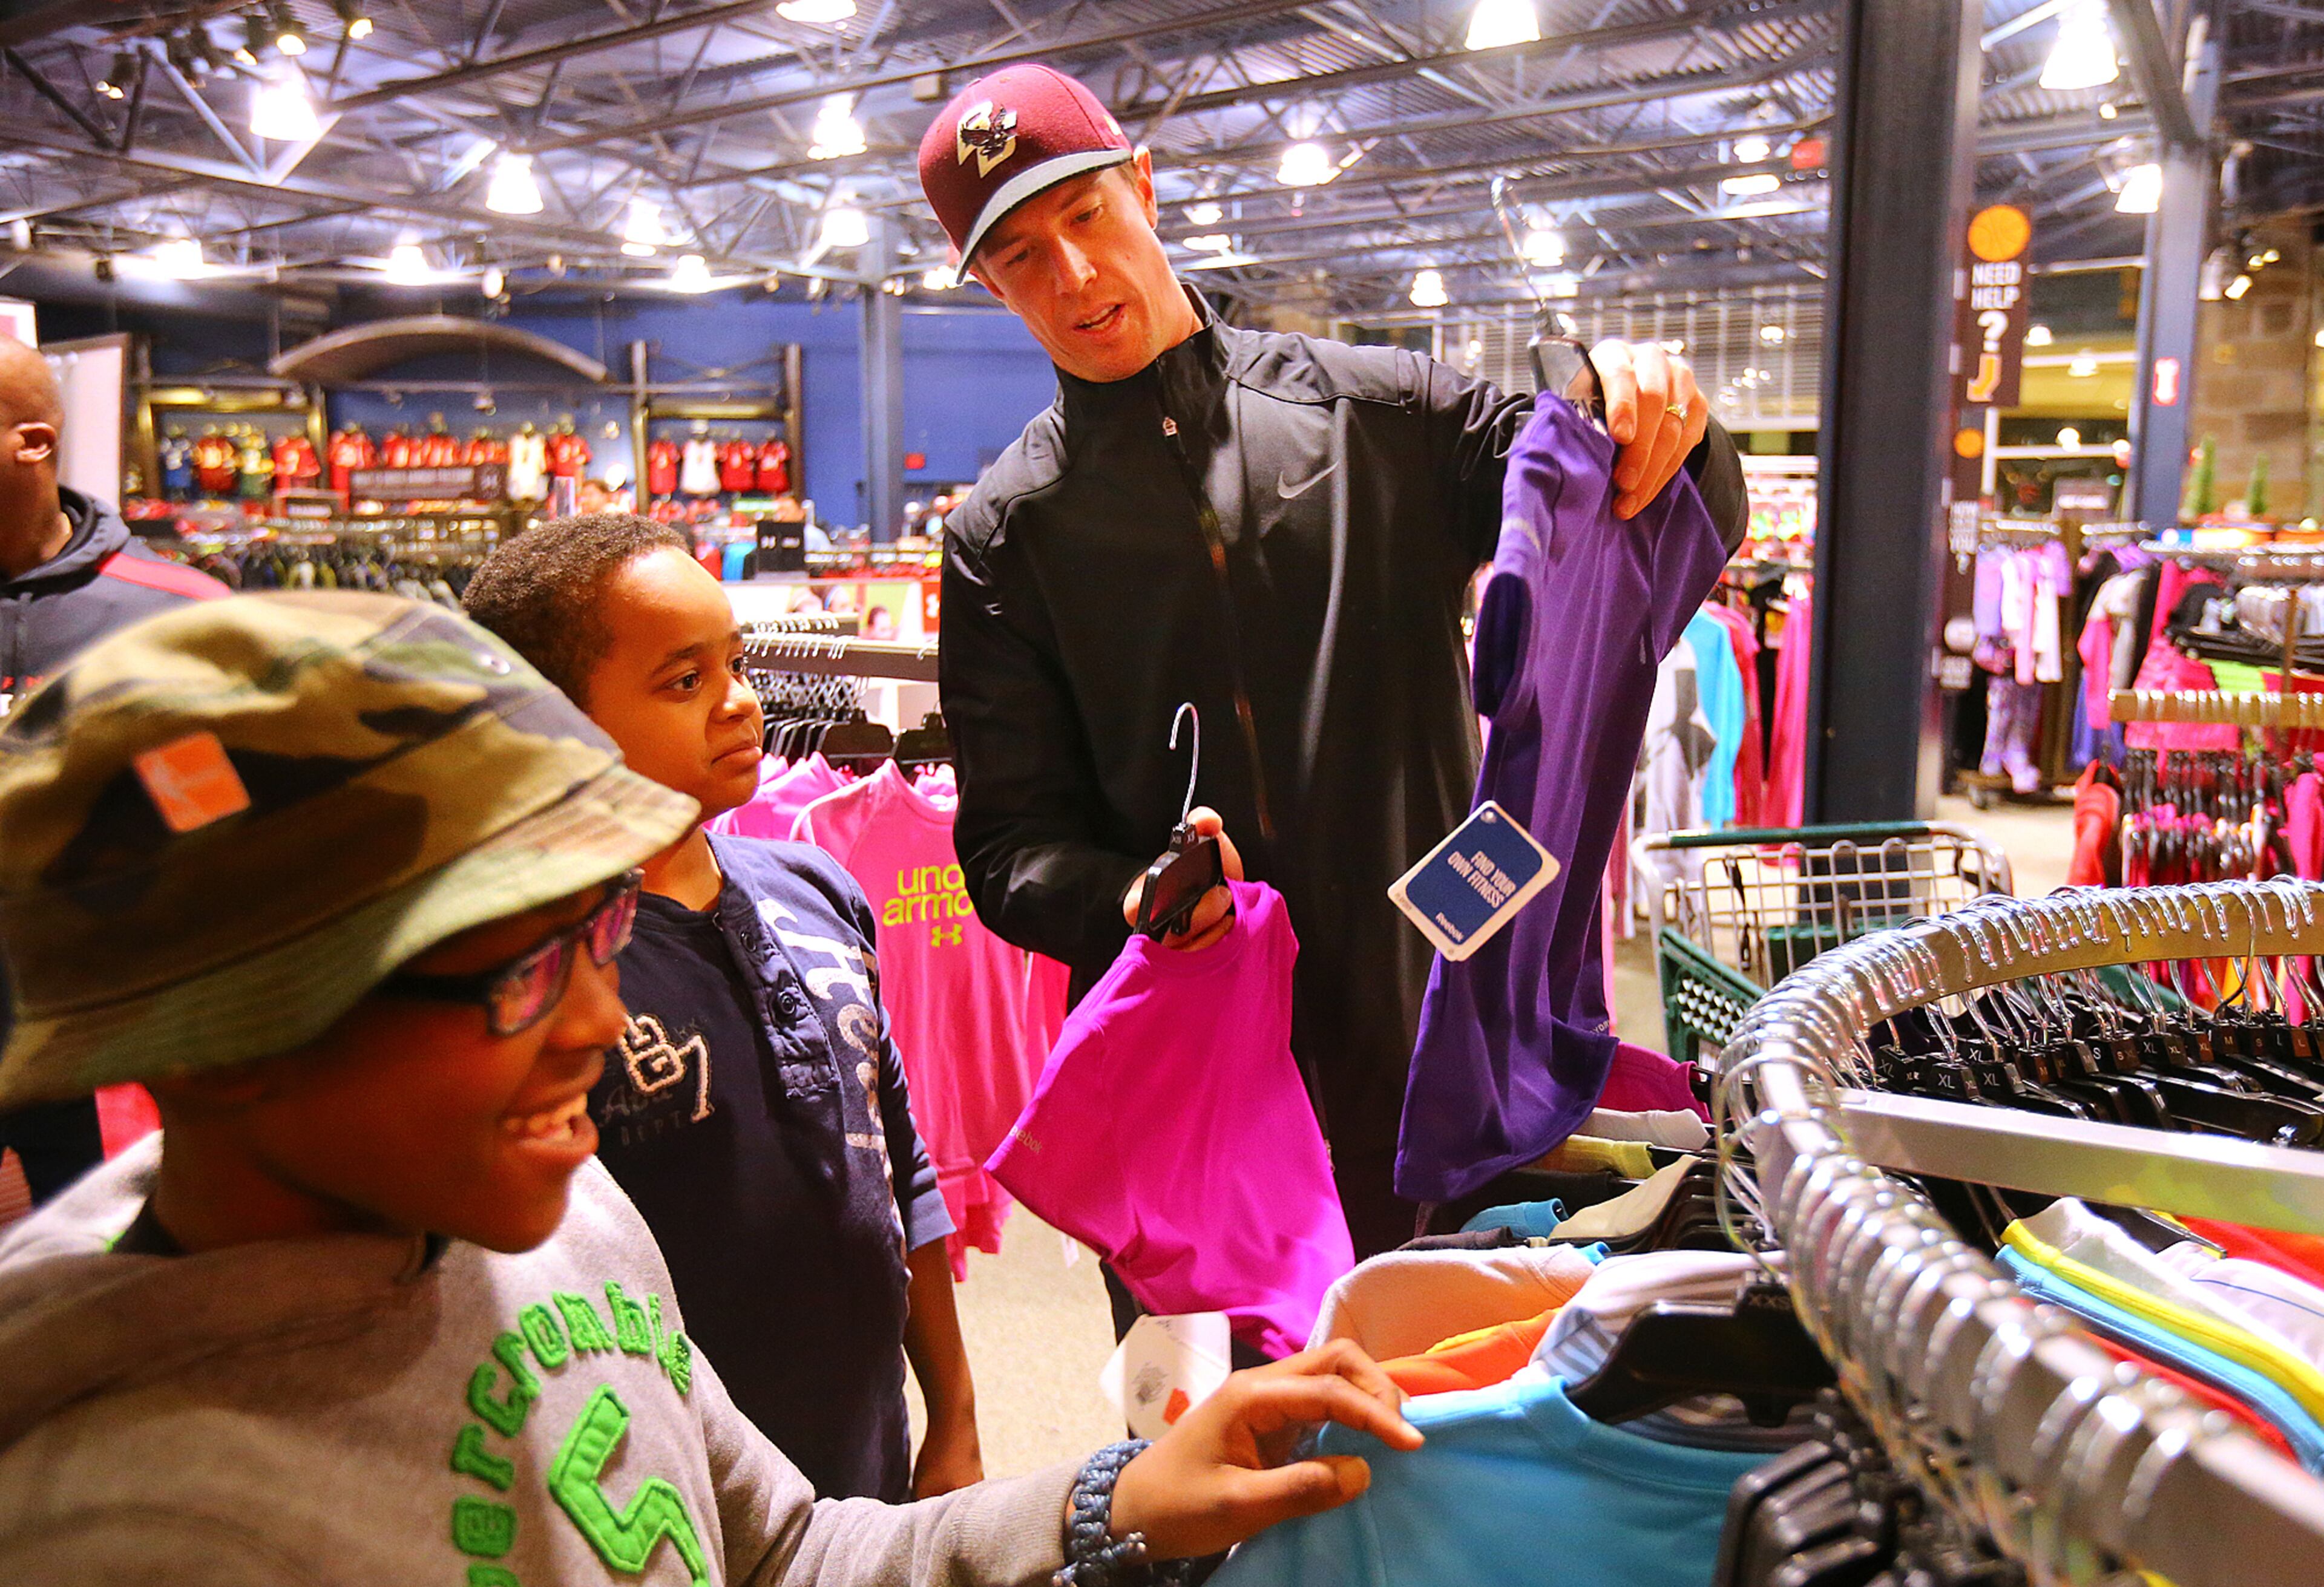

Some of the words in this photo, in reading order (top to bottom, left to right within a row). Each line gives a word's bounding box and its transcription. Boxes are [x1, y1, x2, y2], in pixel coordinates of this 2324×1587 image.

[1972, 261, 2022, 286] NEED
[1971, 286, 2020, 310] HELP
[1977, 310, 2009, 352] ?
[1447, 851, 1474, 878] OWN
[1467, 870, 1505, 908] FITNESS
[1470, 850, 1495, 877] FIND
[1490, 868, 1516, 897] YOUR
[882, 889, 974, 926] armo
[1435, 912, 1465, 942] Reebok
[2143, 1041, 2158, 1054] XL
[2199, 1042, 2209, 1051] XL
[2224, 1036, 2233, 1045] M
[2255, 1038, 2263, 1047] S
[1968, 1047, 1984, 1063] XL
[2093, 1047, 2101, 1060] S
[2116, 1051, 2124, 1061] S
[2168, 1045, 2181, 1054] XL
[1878, 1059, 1894, 1078] XL
[1938, 1073, 1956, 1089] XL
[1983, 1072, 2000, 1087] XL
[1009, 1125, 1043, 1155] eebok
